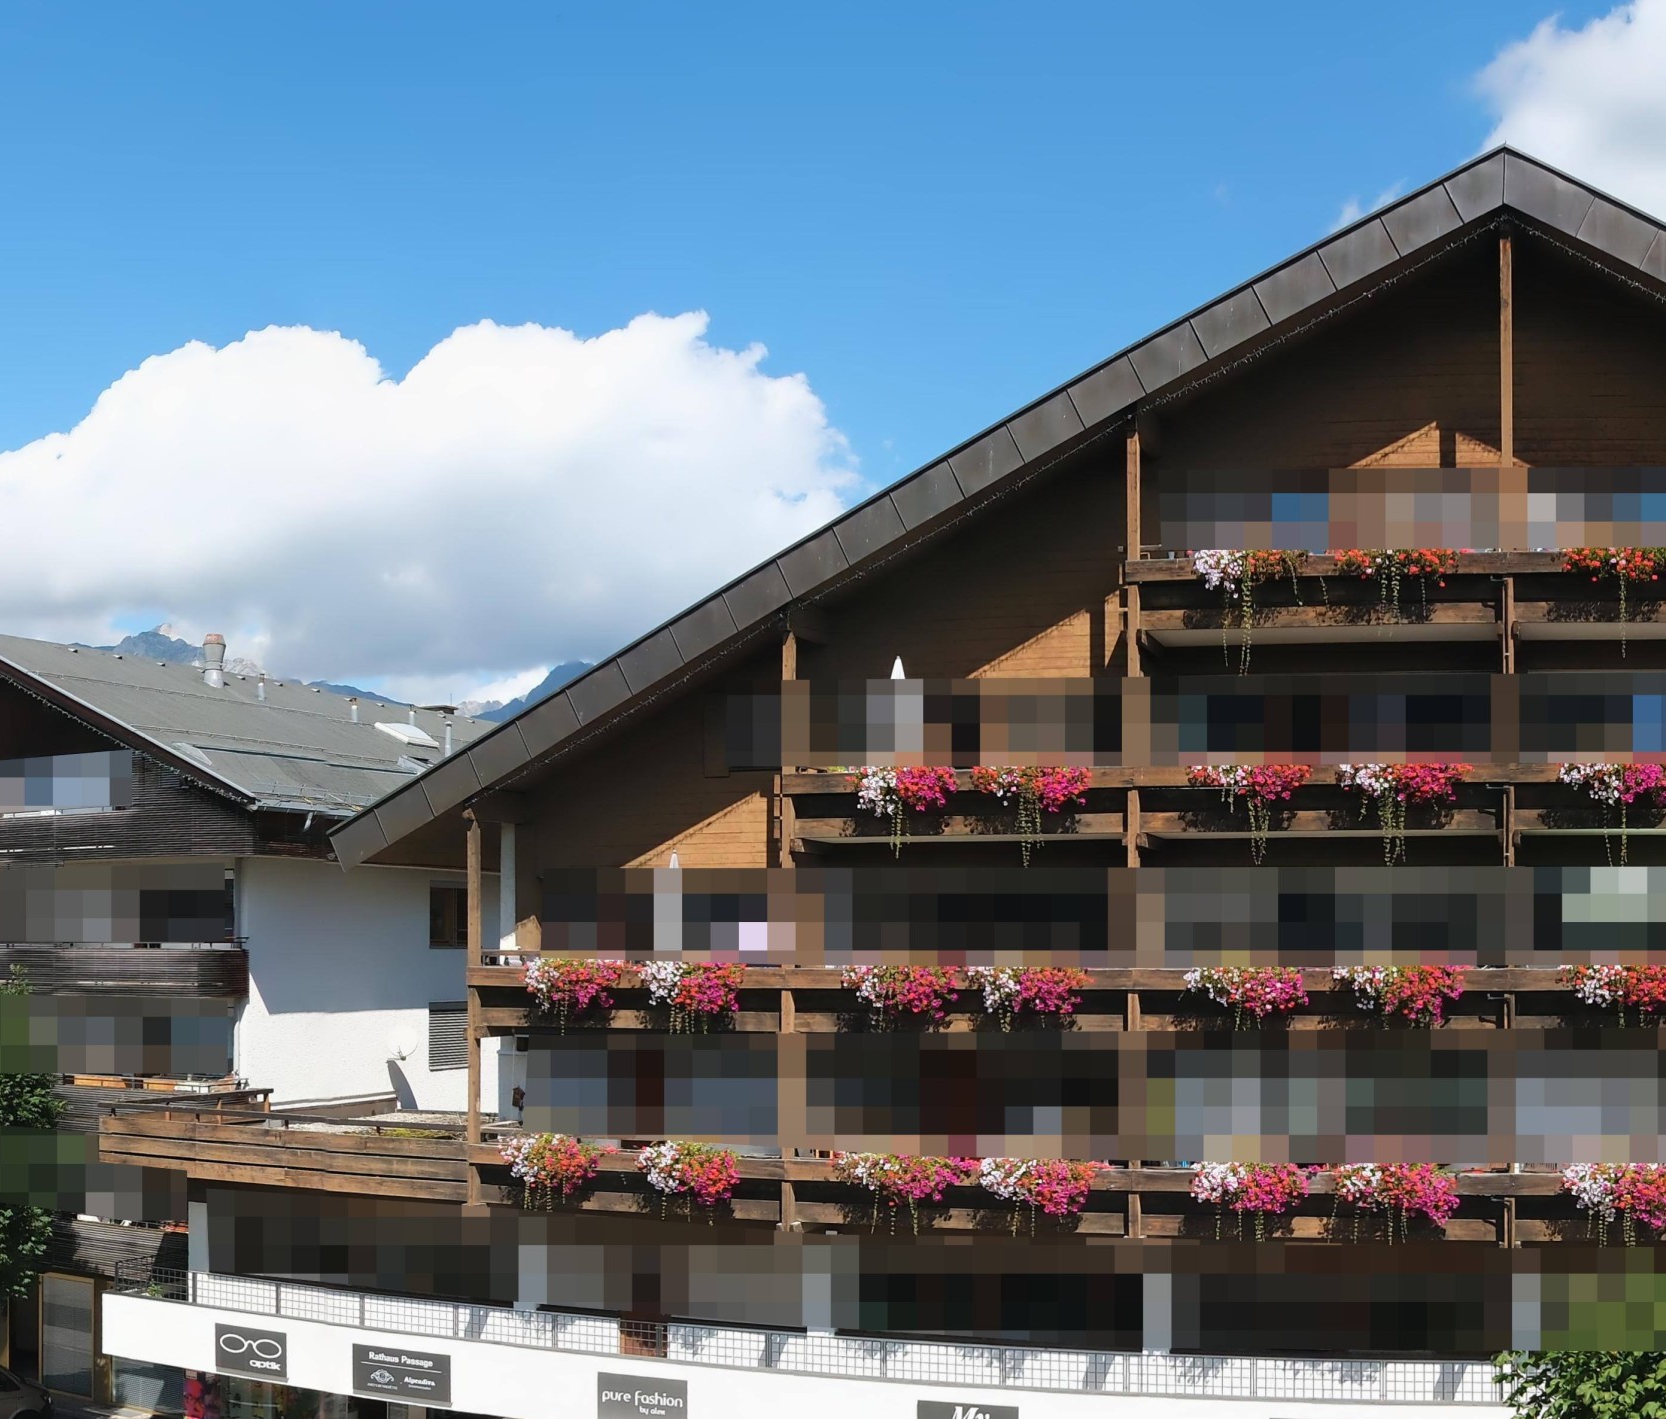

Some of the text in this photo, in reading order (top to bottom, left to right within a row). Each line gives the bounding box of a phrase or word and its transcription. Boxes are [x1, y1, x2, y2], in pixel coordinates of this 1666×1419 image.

[249, 1359, 282, 1371] optik
[368, 1350, 434, 1369] Rathaus Passage
[601, 1390, 683, 1408] pure fashion
[639, 1405, 650, 1415] by
